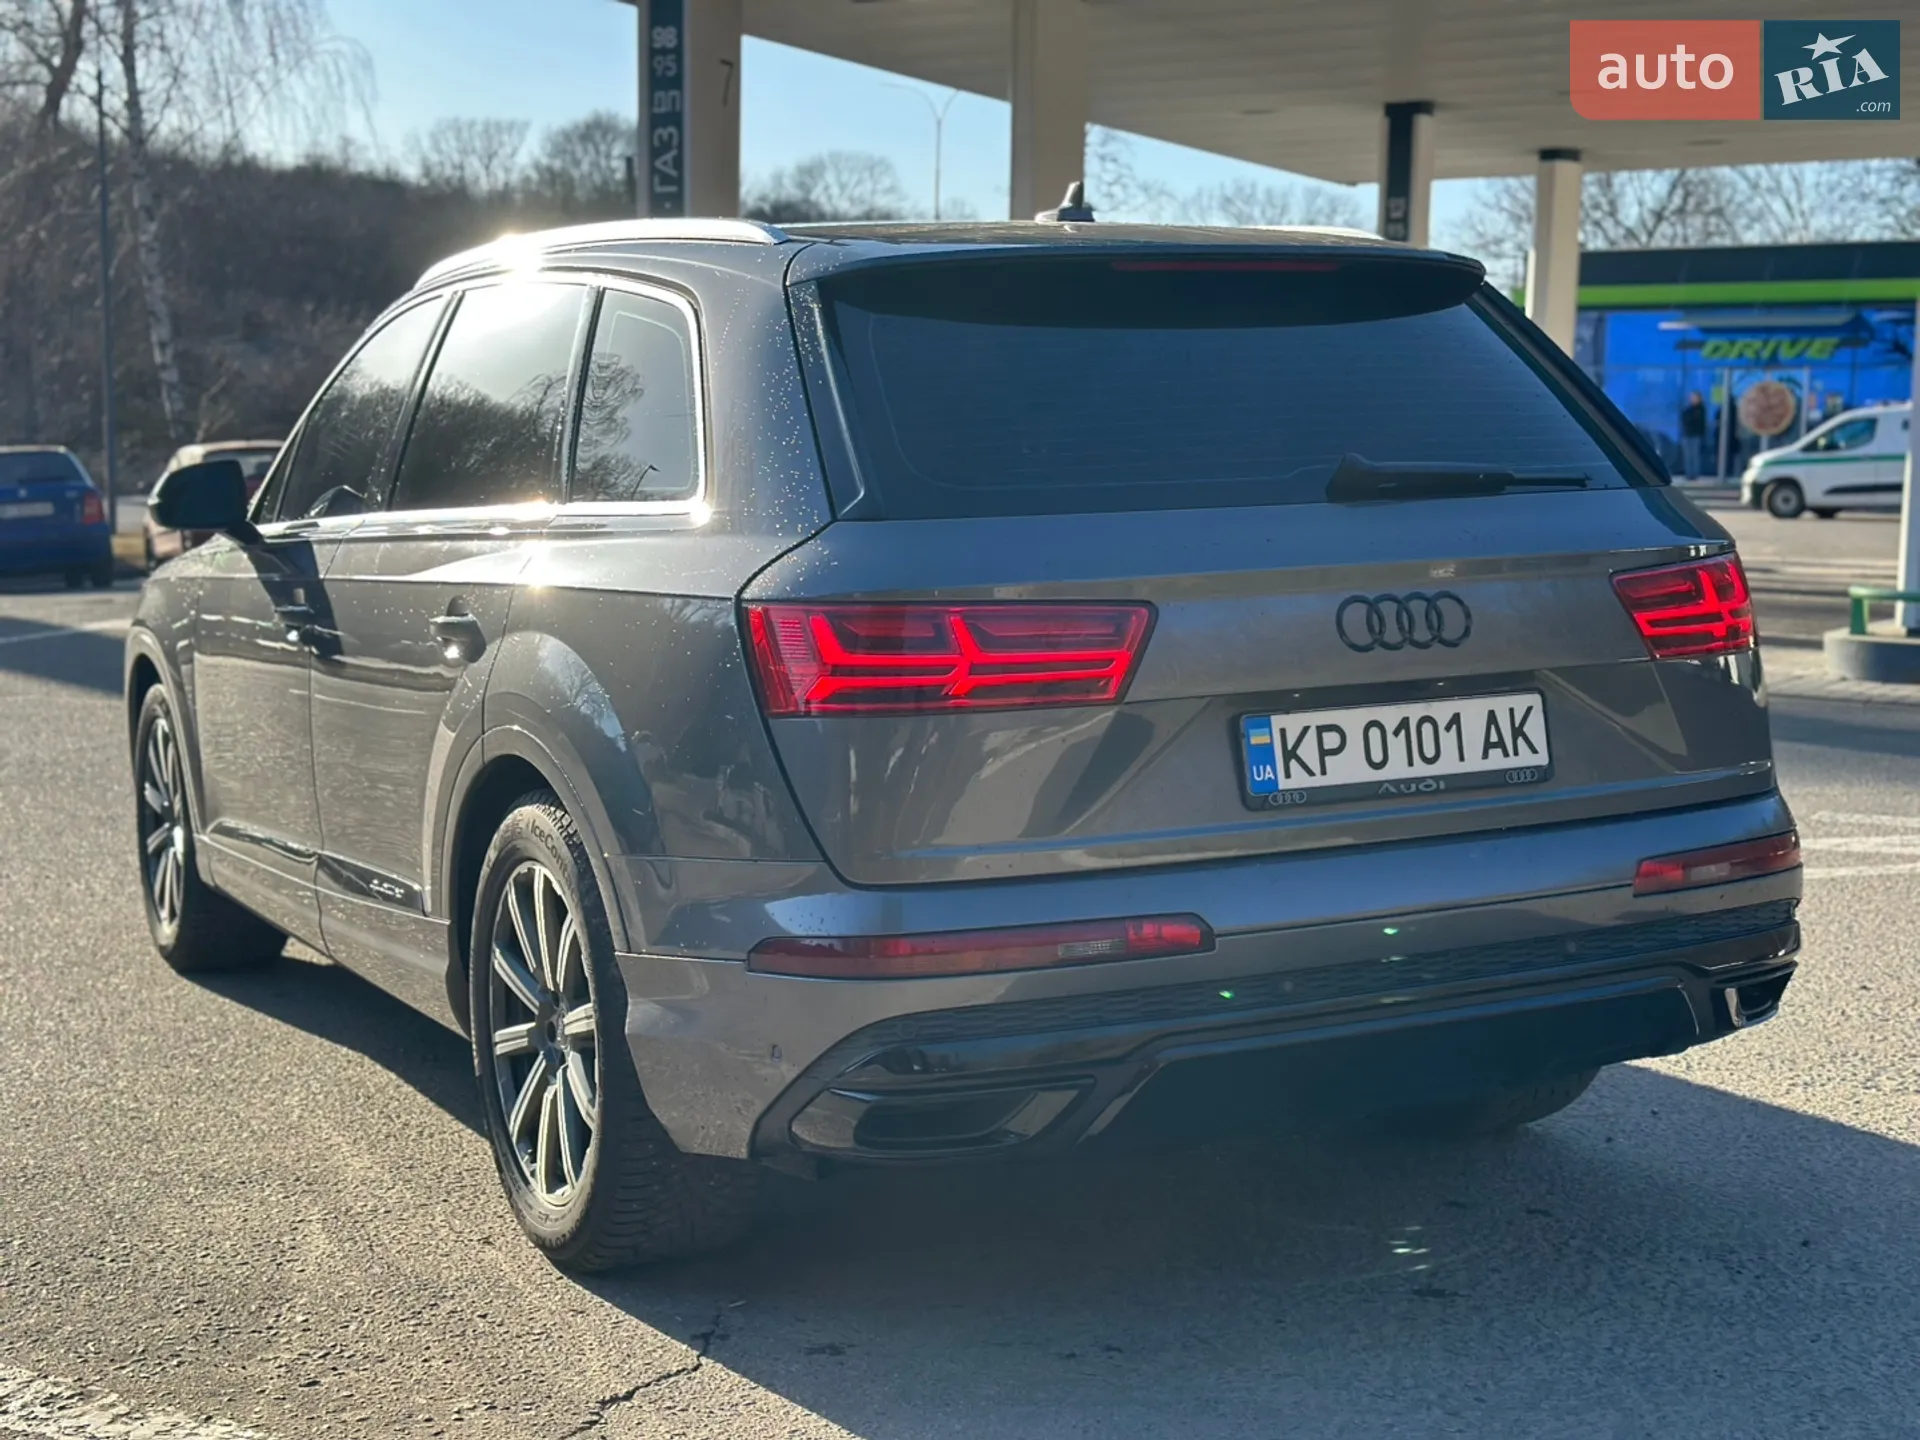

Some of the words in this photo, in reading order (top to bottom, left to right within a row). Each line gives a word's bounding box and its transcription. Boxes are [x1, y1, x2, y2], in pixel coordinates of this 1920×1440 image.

[653, 125, 679, 193] ГАЗ
[1702, 336, 1840, 360] DRIVE
[1279, 723, 1347, 780] KP
[1363, 712, 1465, 771] 0101
[1481, 705, 1540, 760] AK
[1252, 765, 1276, 782] UA
[1379, 778, 1446, 794] Audi
